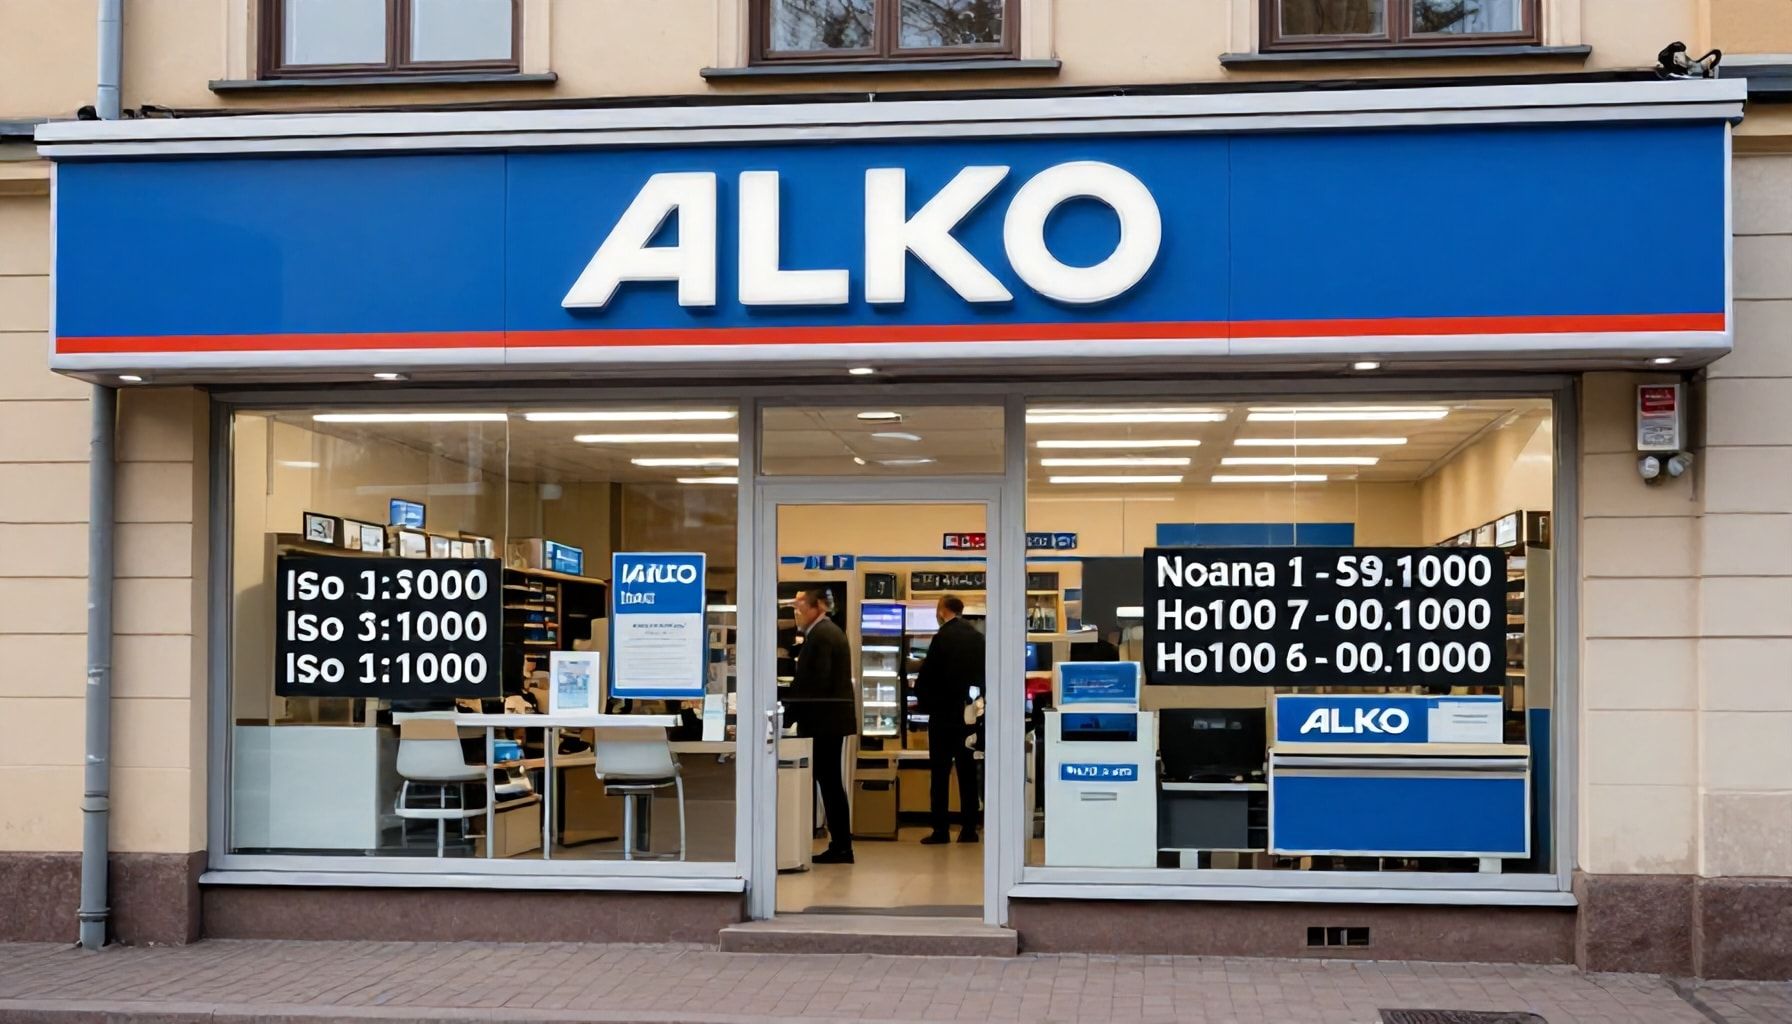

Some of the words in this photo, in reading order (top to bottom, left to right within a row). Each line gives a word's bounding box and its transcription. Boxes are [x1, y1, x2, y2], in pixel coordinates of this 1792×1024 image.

[561, 160, 1162, 308] ALKO
[1157, 555, 1276, 588] Noana
[358, 652, 488, 684] 1:1000
[1300, 707, 1410, 735] ALKO
